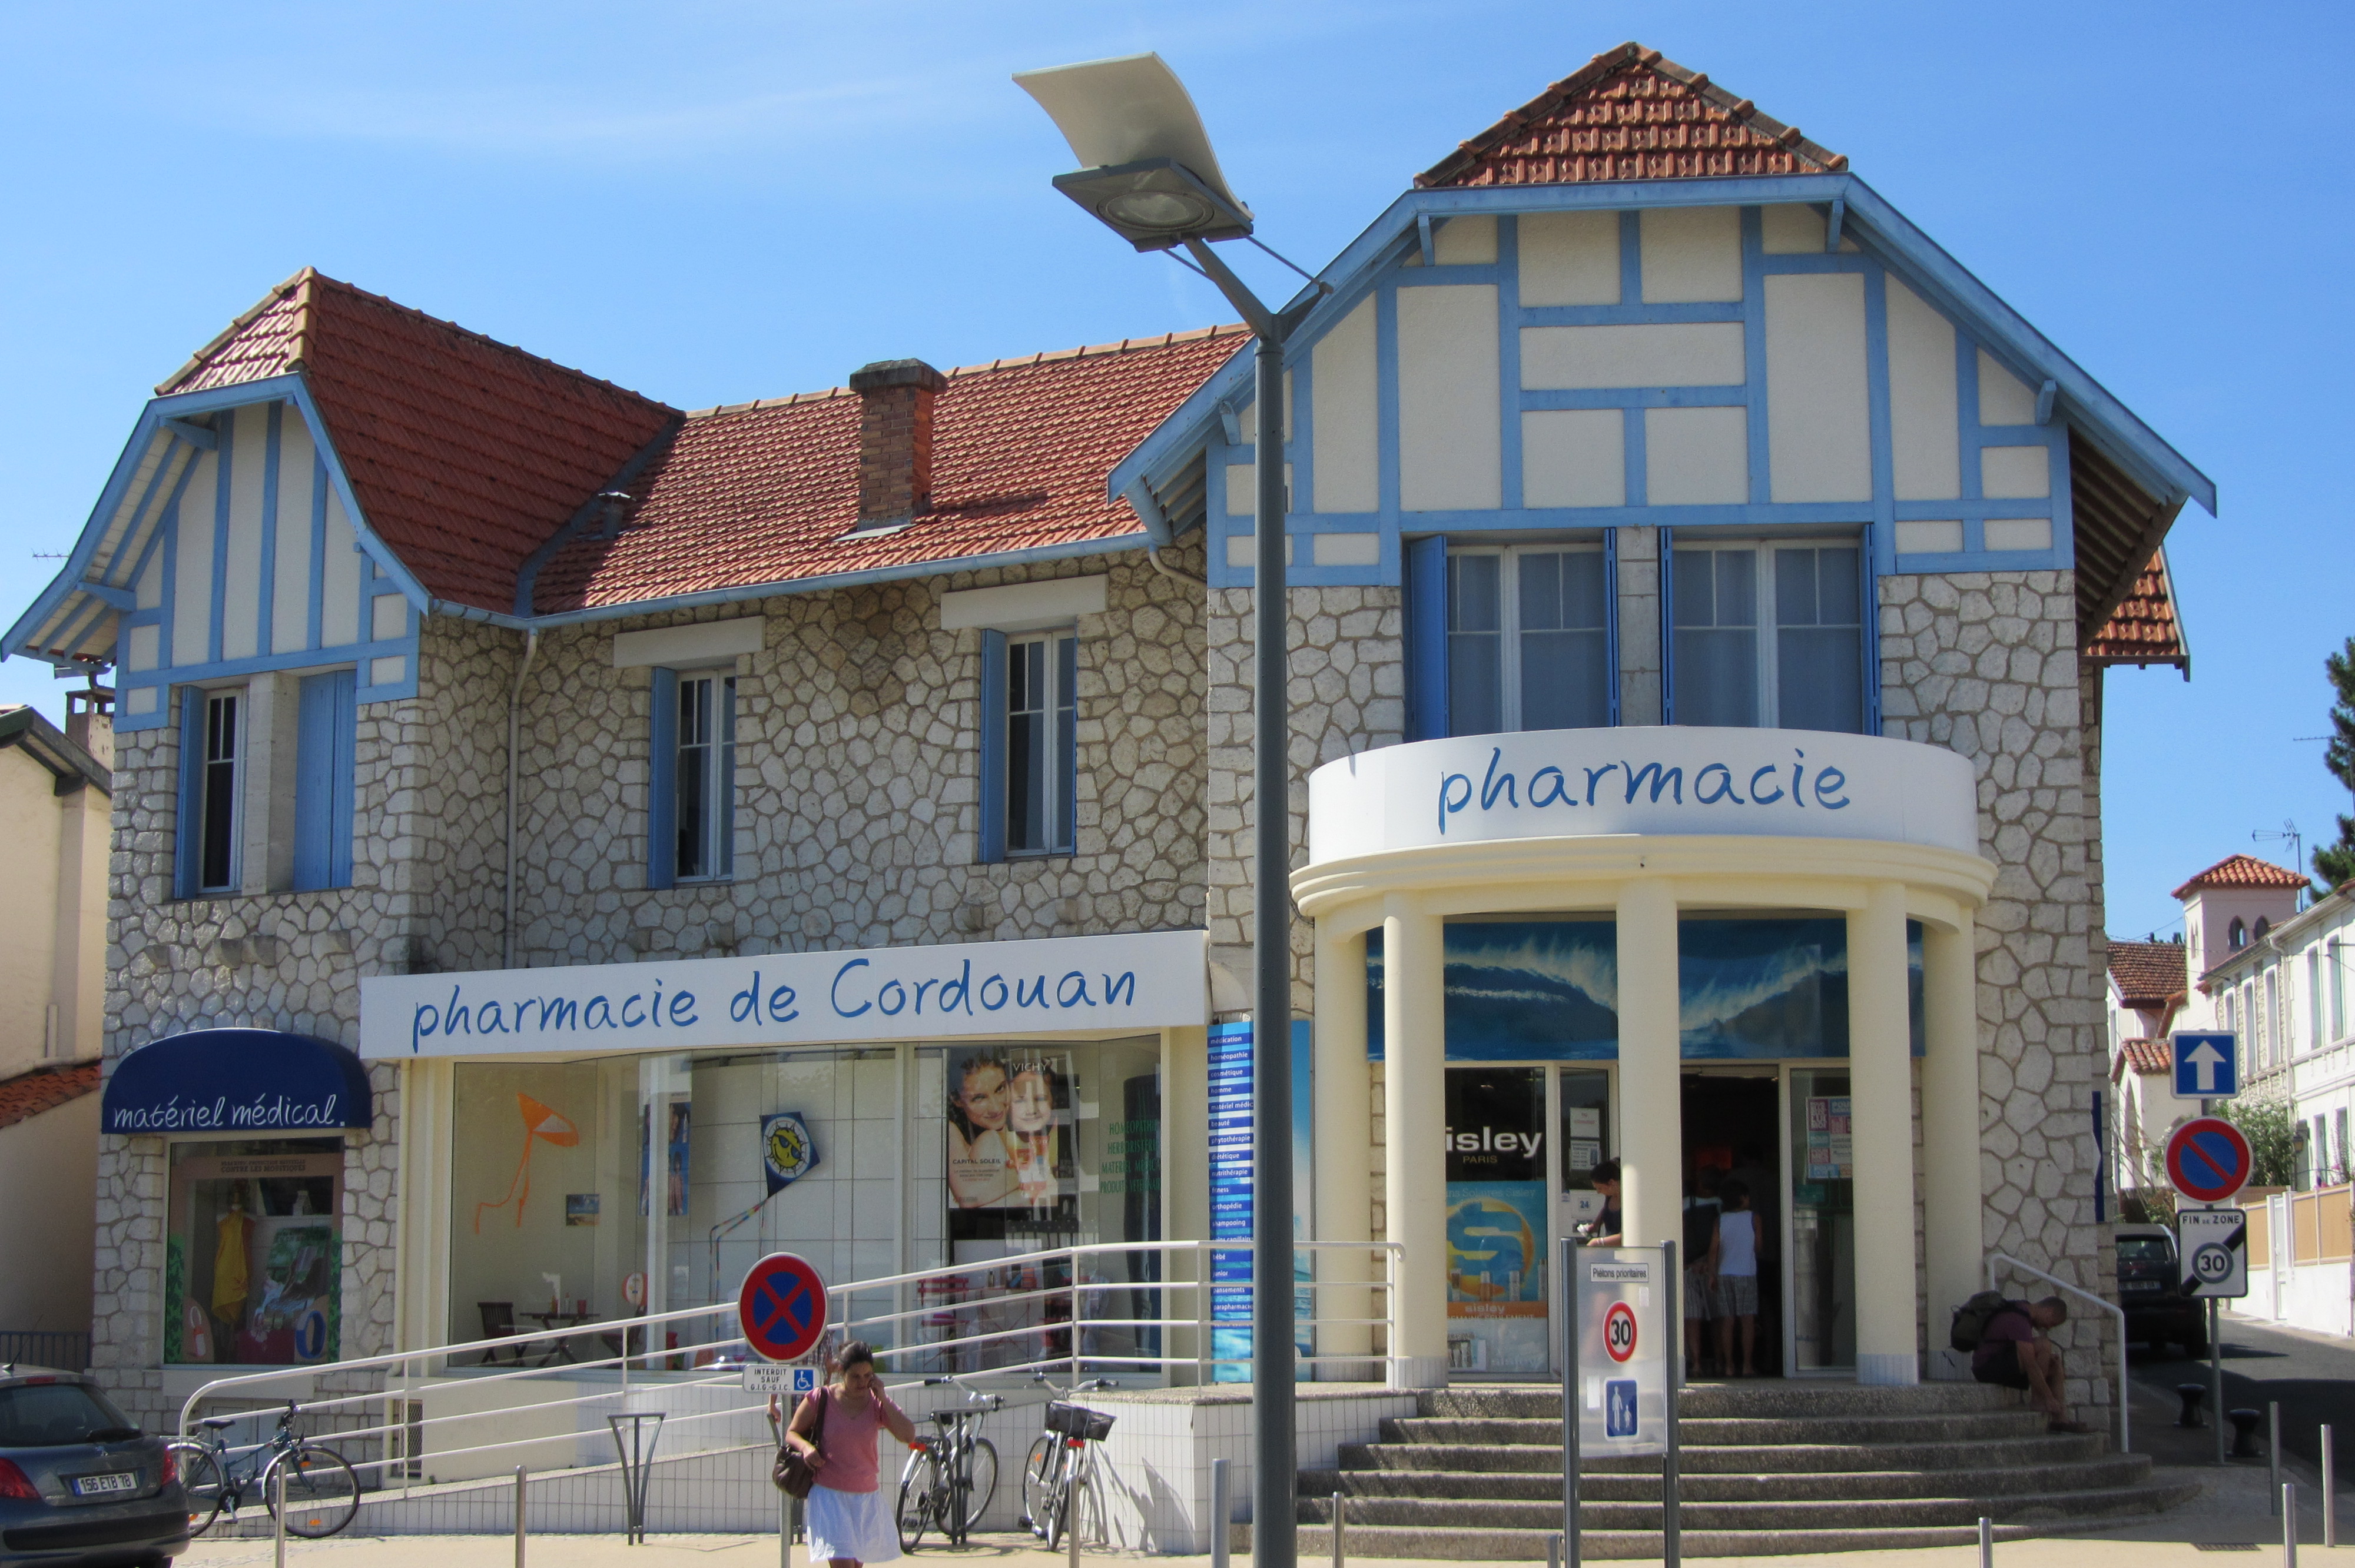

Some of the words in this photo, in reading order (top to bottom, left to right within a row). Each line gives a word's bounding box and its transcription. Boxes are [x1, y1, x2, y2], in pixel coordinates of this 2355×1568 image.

[1439, 748, 1850, 835] pharmacie
[413, 979, 699, 1053] pharmacie
[731, 971, 800, 1025] de
[831, 958, 1136, 1018] Cordouan
[1210, 1036, 1242, 1045] médication
[1210, 1051, 1248, 1061] homéopathie
[1013, 1062, 1048, 1071] VICHY
[1210, 1069, 1243, 1078] cosmétique
[114, 1095, 226, 1128] matériel
[232, 1093, 337, 1127] médical
[1211, 1102, 1234, 1111] matériel
[1211, 1134, 1251, 1144] phytothérapie
[1446, 1125, 1543, 1158] isley
[1462, 1155, 1498, 1164] PARIS
[1212, 1168, 1248, 1177] nutrithérapie
[1100, 1179, 1128, 1194] PRODUIT
[1212, 1202, 1242, 1211] orthopédie
[2182, 1215, 2200, 1224] FIN
[2213, 1215, 2240, 1224] ZONE
[2200, 1254, 2225, 1272] 30
[1593, 1268, 1615, 1278] Piétons
[1616, 1268, 1647, 1279] prioritaires
[1465, 1303, 1505, 1314] sisley
[1610, 1318, 1631, 1346] 30
[81, 1477, 99, 1492] 156
[100, 1475, 118, 1490] ETB
[118, 1474, 132, 1488] 78
